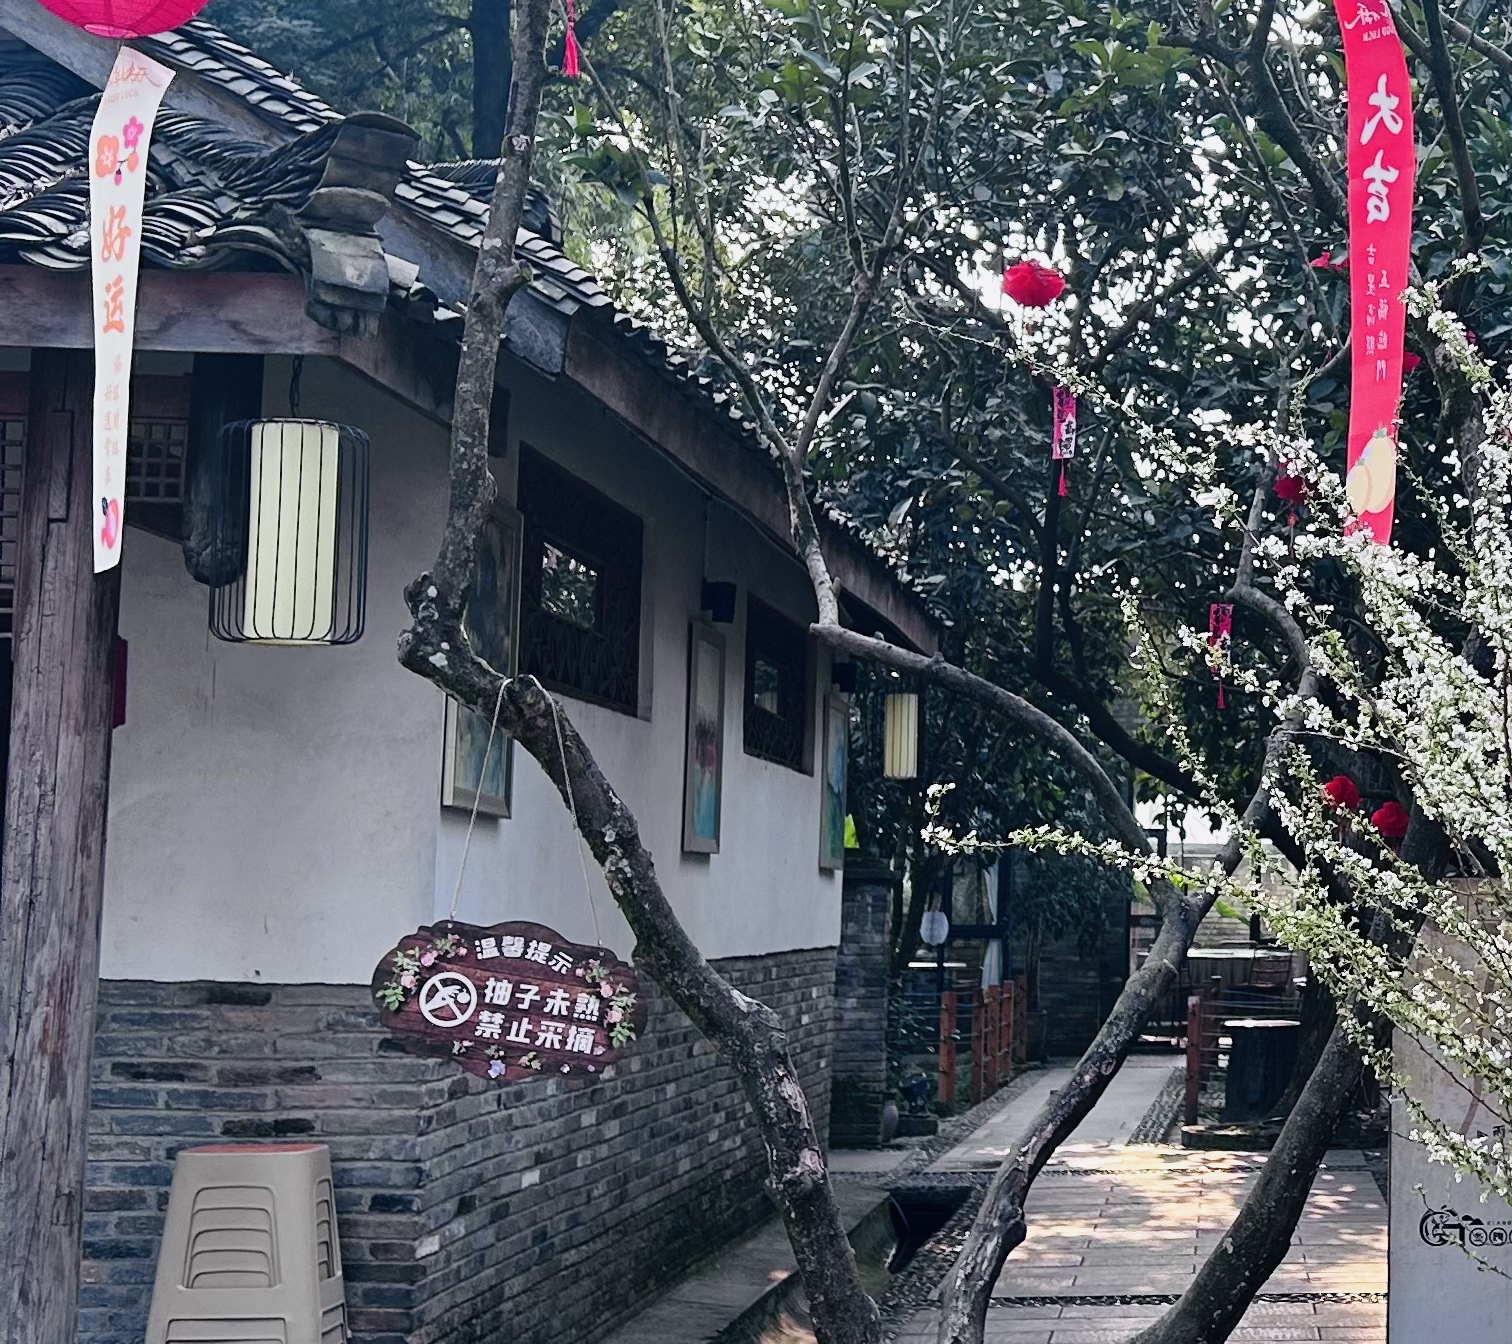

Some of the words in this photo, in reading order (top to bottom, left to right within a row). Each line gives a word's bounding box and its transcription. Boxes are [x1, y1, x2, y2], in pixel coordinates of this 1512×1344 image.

[101, 205, 131, 333] 好运
[474, 936, 574, 975] 温馨提示
[484, 977, 600, 1022] 柚子未熟
[474, 1010, 596, 1055] 禁止采摘
